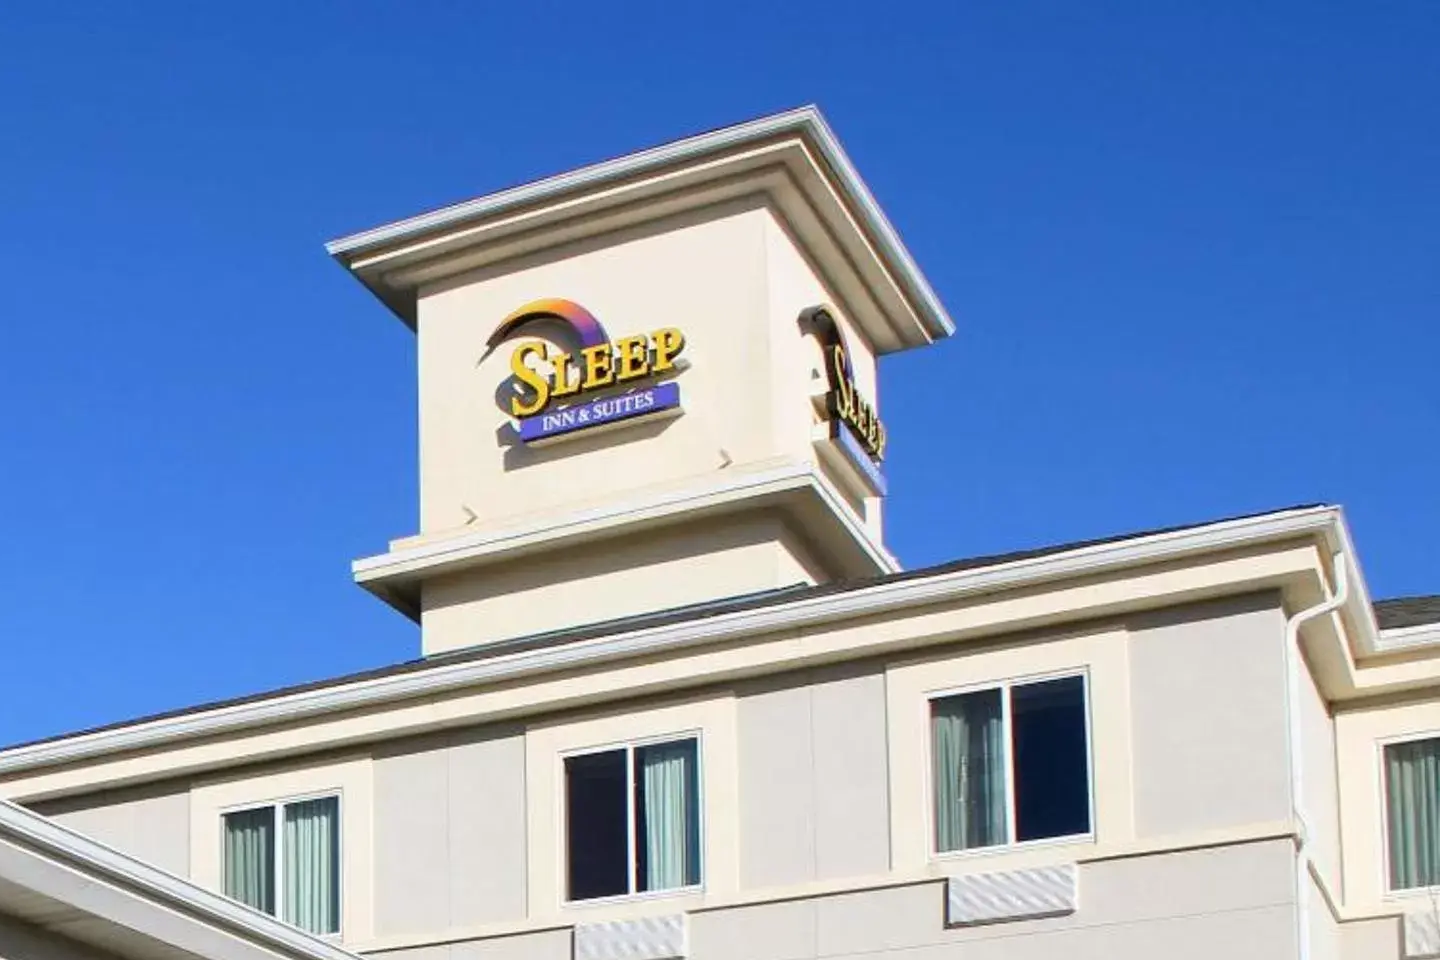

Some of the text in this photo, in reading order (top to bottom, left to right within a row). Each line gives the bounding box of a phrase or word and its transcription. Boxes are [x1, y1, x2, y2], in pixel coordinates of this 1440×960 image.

[511, 327, 685, 416] SLEEP
[543, 391, 655, 431] INN & SUITES
